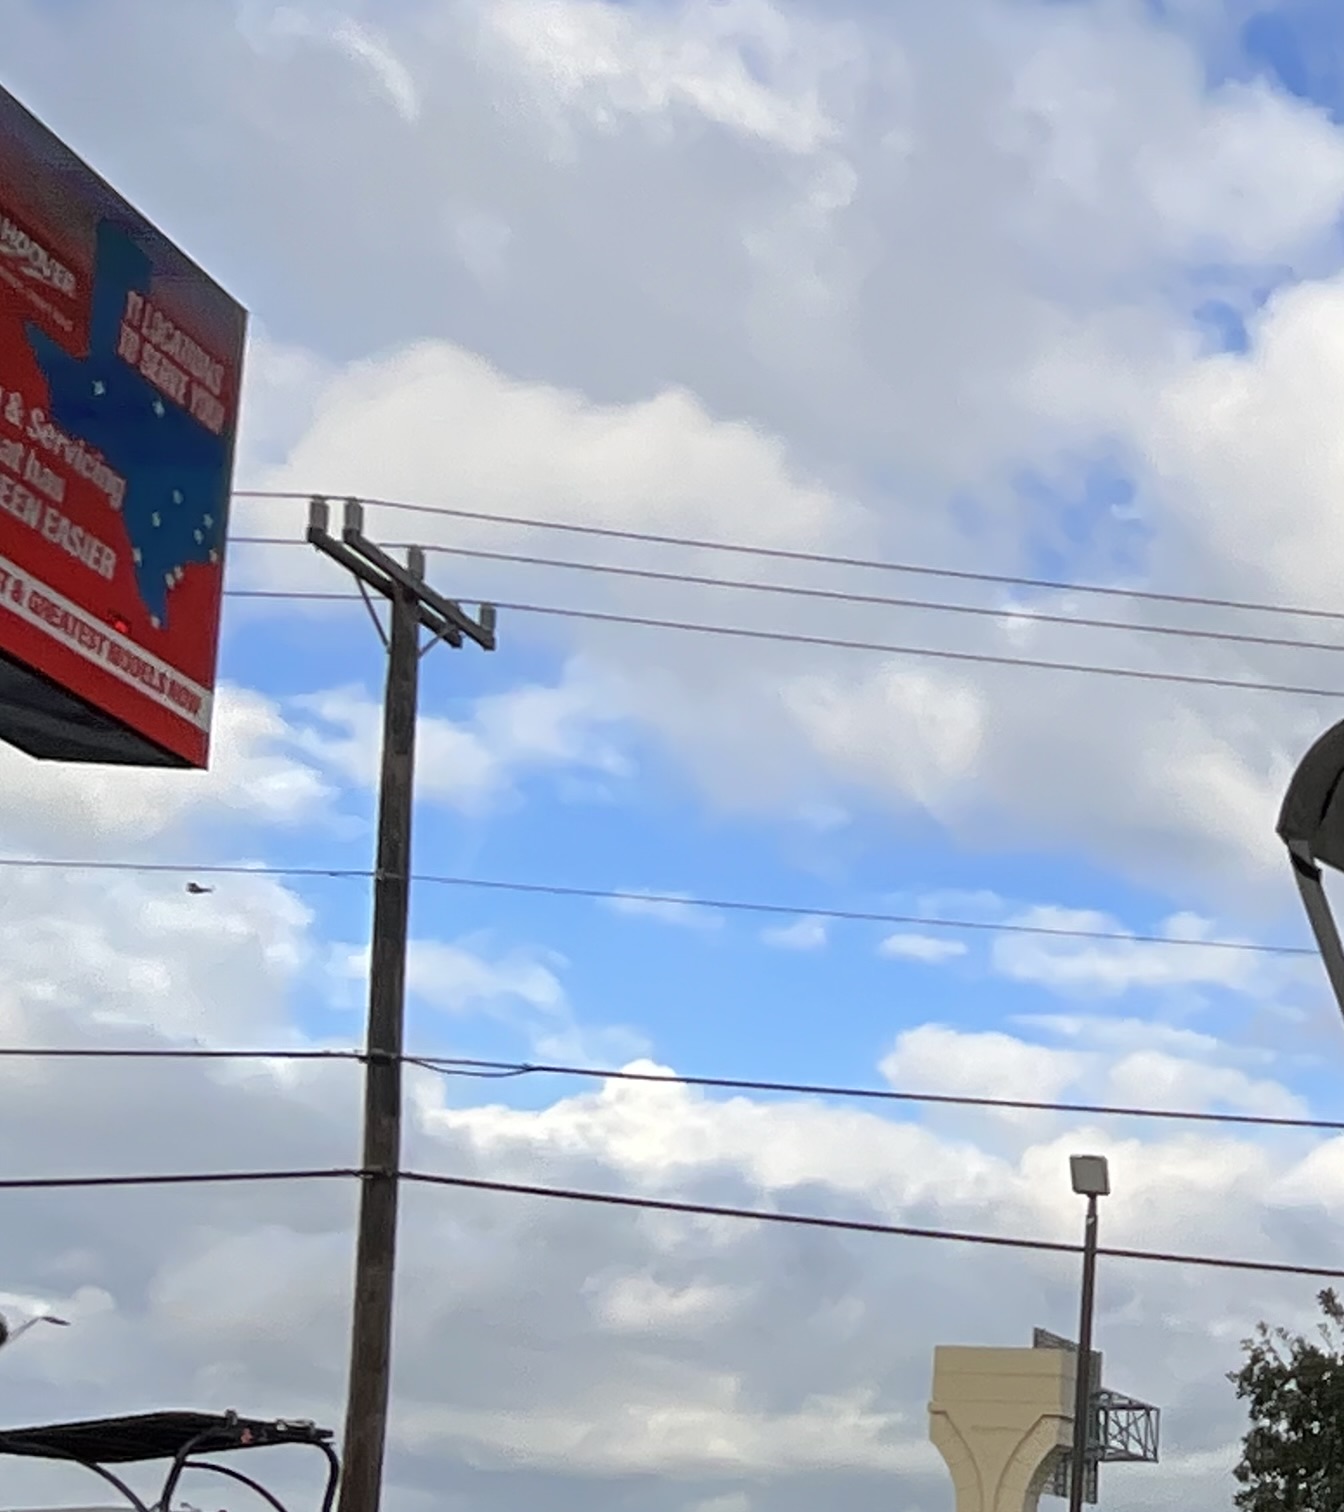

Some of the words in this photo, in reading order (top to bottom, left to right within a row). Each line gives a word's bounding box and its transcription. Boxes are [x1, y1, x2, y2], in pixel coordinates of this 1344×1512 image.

[26, 407, 127, 511] Servicing
[0, 474, 42, 530] EEN
[41, 503, 117, 581] EASIER
